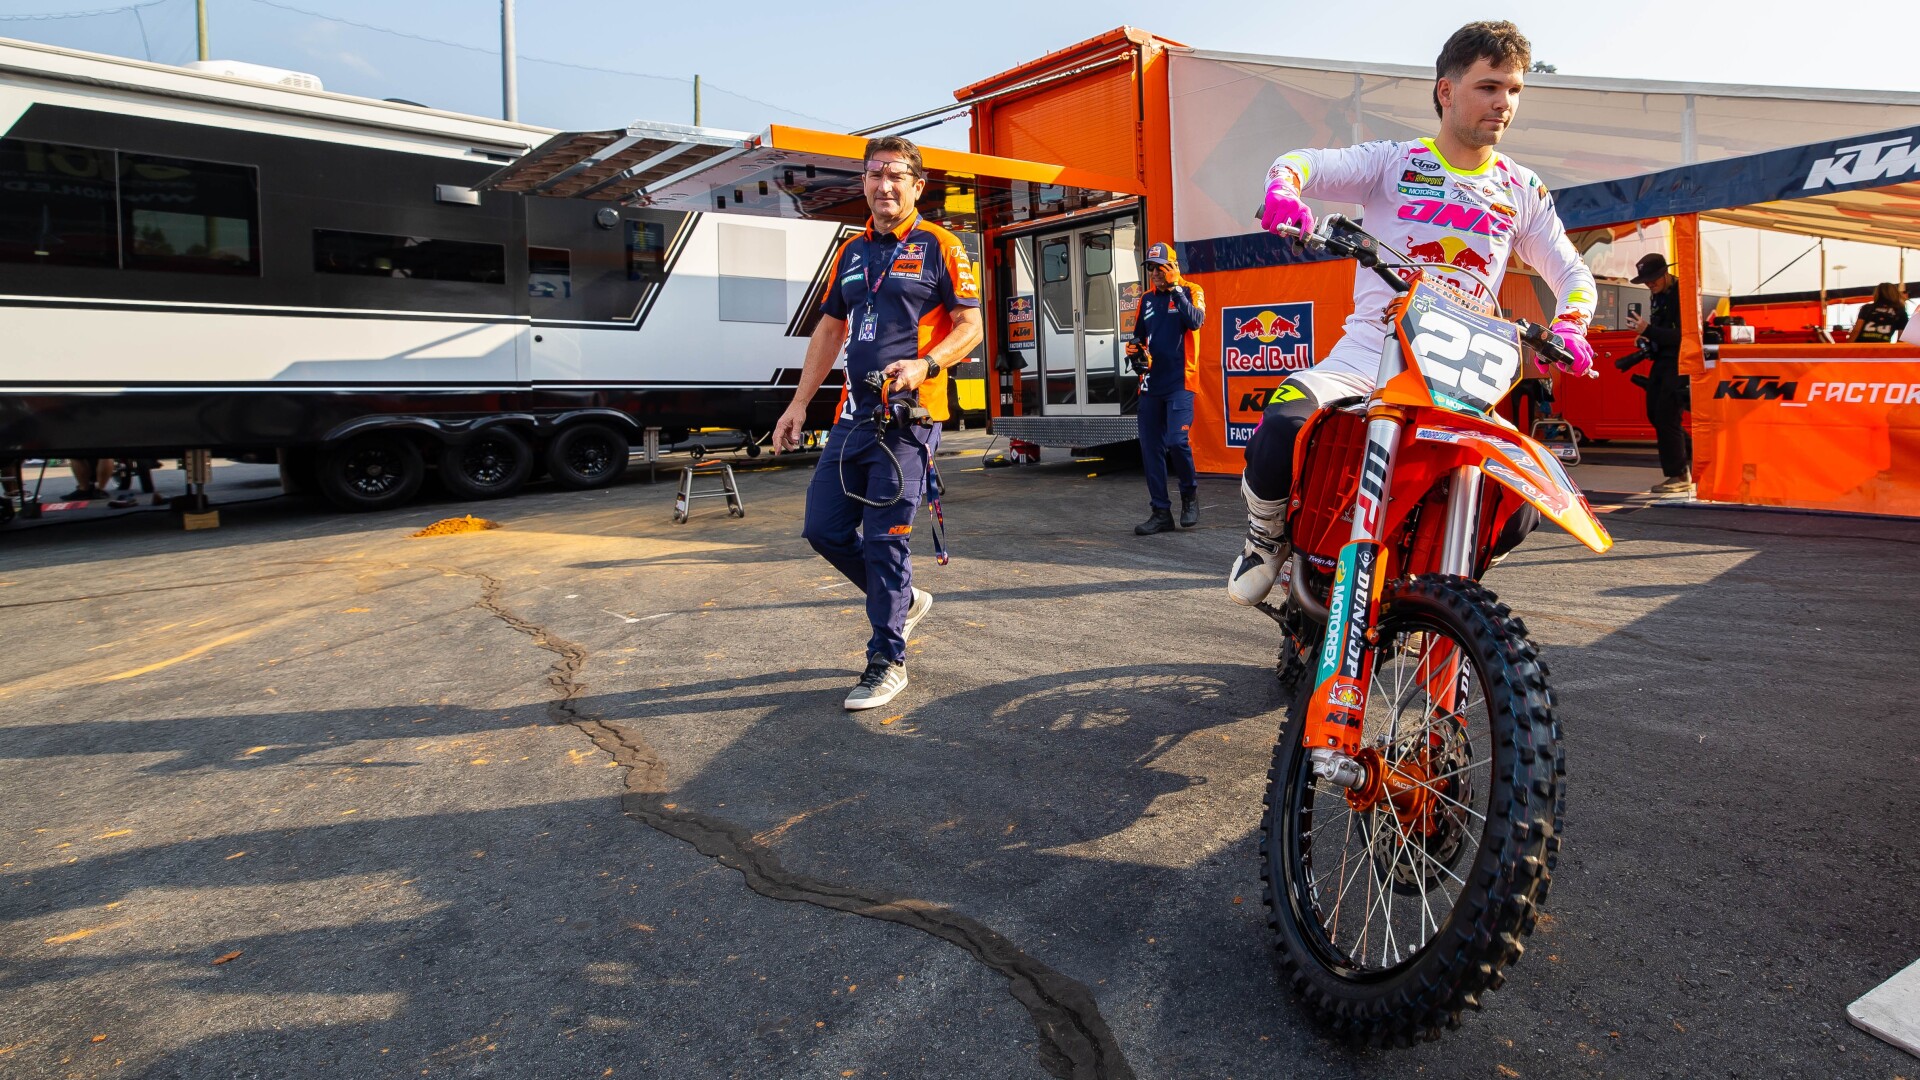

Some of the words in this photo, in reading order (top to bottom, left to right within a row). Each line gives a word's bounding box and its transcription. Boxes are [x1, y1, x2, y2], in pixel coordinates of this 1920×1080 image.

[1408, 188, 1441, 197] MOTOREX
[1120, 298, 1134, 310] Red
[1009, 311, 1020, 322] Red
[1020, 310, 1033, 321] Bull
[1013, 326, 1030, 337] KTM
[1226, 345, 1267, 372] Red
[1268, 344, 1310, 371] Bull
[1410, 311, 1519, 405] 23
[1713, 375, 1798, 400] KTM
[1239, 388, 1279, 412] KT
[1230, 427, 1256, 441] FACT
[1358, 439, 1390, 538] WP
[888, 525, 913, 535] KTM
[1309, 555, 1324, 564] Twin
[1323, 585, 1345, 669] MOTOREX
[1346, 569, 1370, 678] DUNLOP
[1325, 711, 1361, 729] KTM
